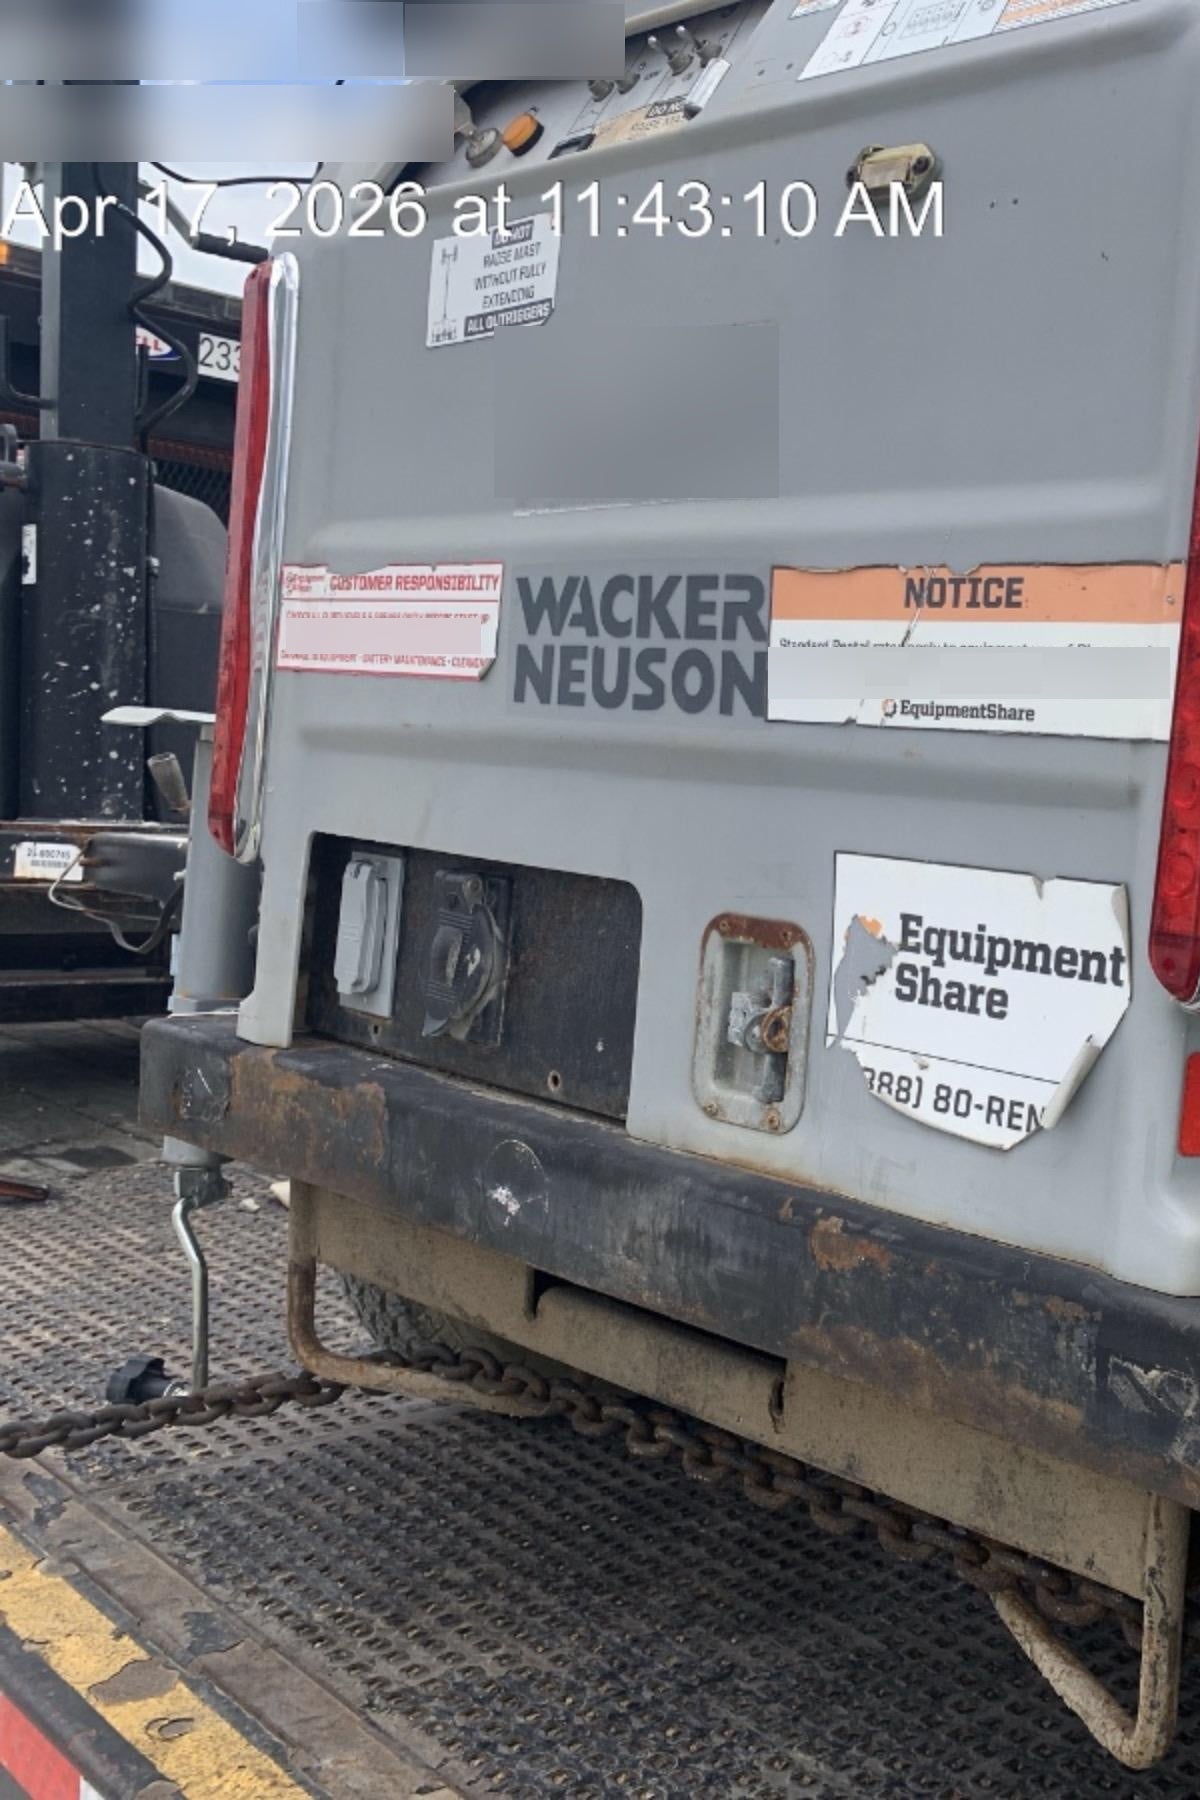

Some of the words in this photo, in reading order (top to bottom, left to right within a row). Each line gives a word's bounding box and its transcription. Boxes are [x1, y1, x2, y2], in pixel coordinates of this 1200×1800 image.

[467, 318, 484, 332] ALL
[330, 575, 393, 591] CUSTOMER
[395, 574, 499, 591] RESPONSIBILITY
[904, 577, 1025, 609] NOTICE
[516, 574, 768, 641] WACKER
[513, 644, 768, 718] NEUSON
[899, 699, 1036, 722] EquipmentShare
[899, 912, 1127, 987] Equipment
[894, 963, 1009, 1020] Share
